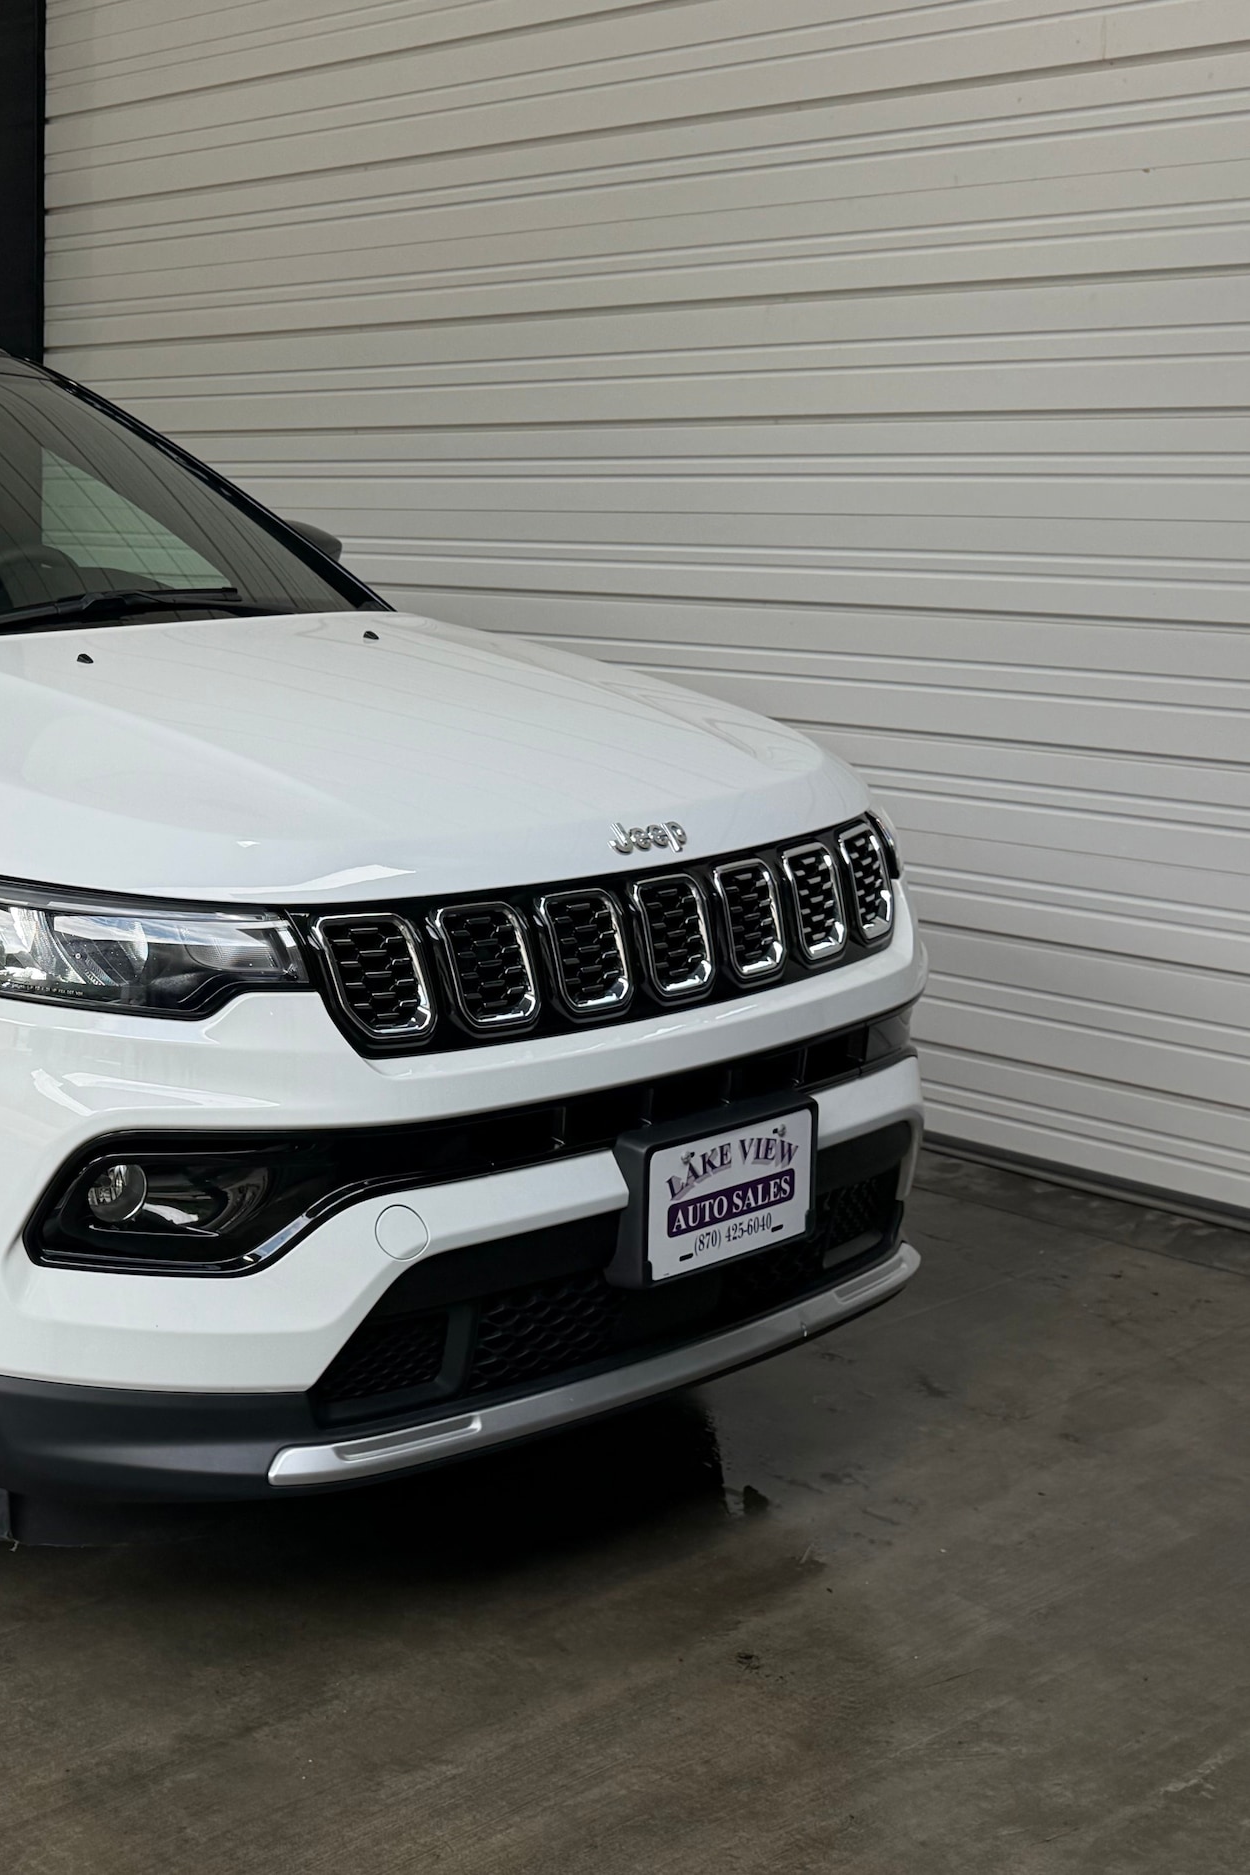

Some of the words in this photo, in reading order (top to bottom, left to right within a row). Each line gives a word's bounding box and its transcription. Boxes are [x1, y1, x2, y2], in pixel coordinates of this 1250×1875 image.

[606, 820, 688, 856] Jeep
[665, 1142, 732, 1200] LAKE
[739, 1137, 799, 1168] VIEW
[671, 1194, 728, 1233] AUTO
[732, 1175, 791, 1214] SALES
[694, 1234, 722, 1257] (870)
[724, 1212, 773, 1243] 425-6040
